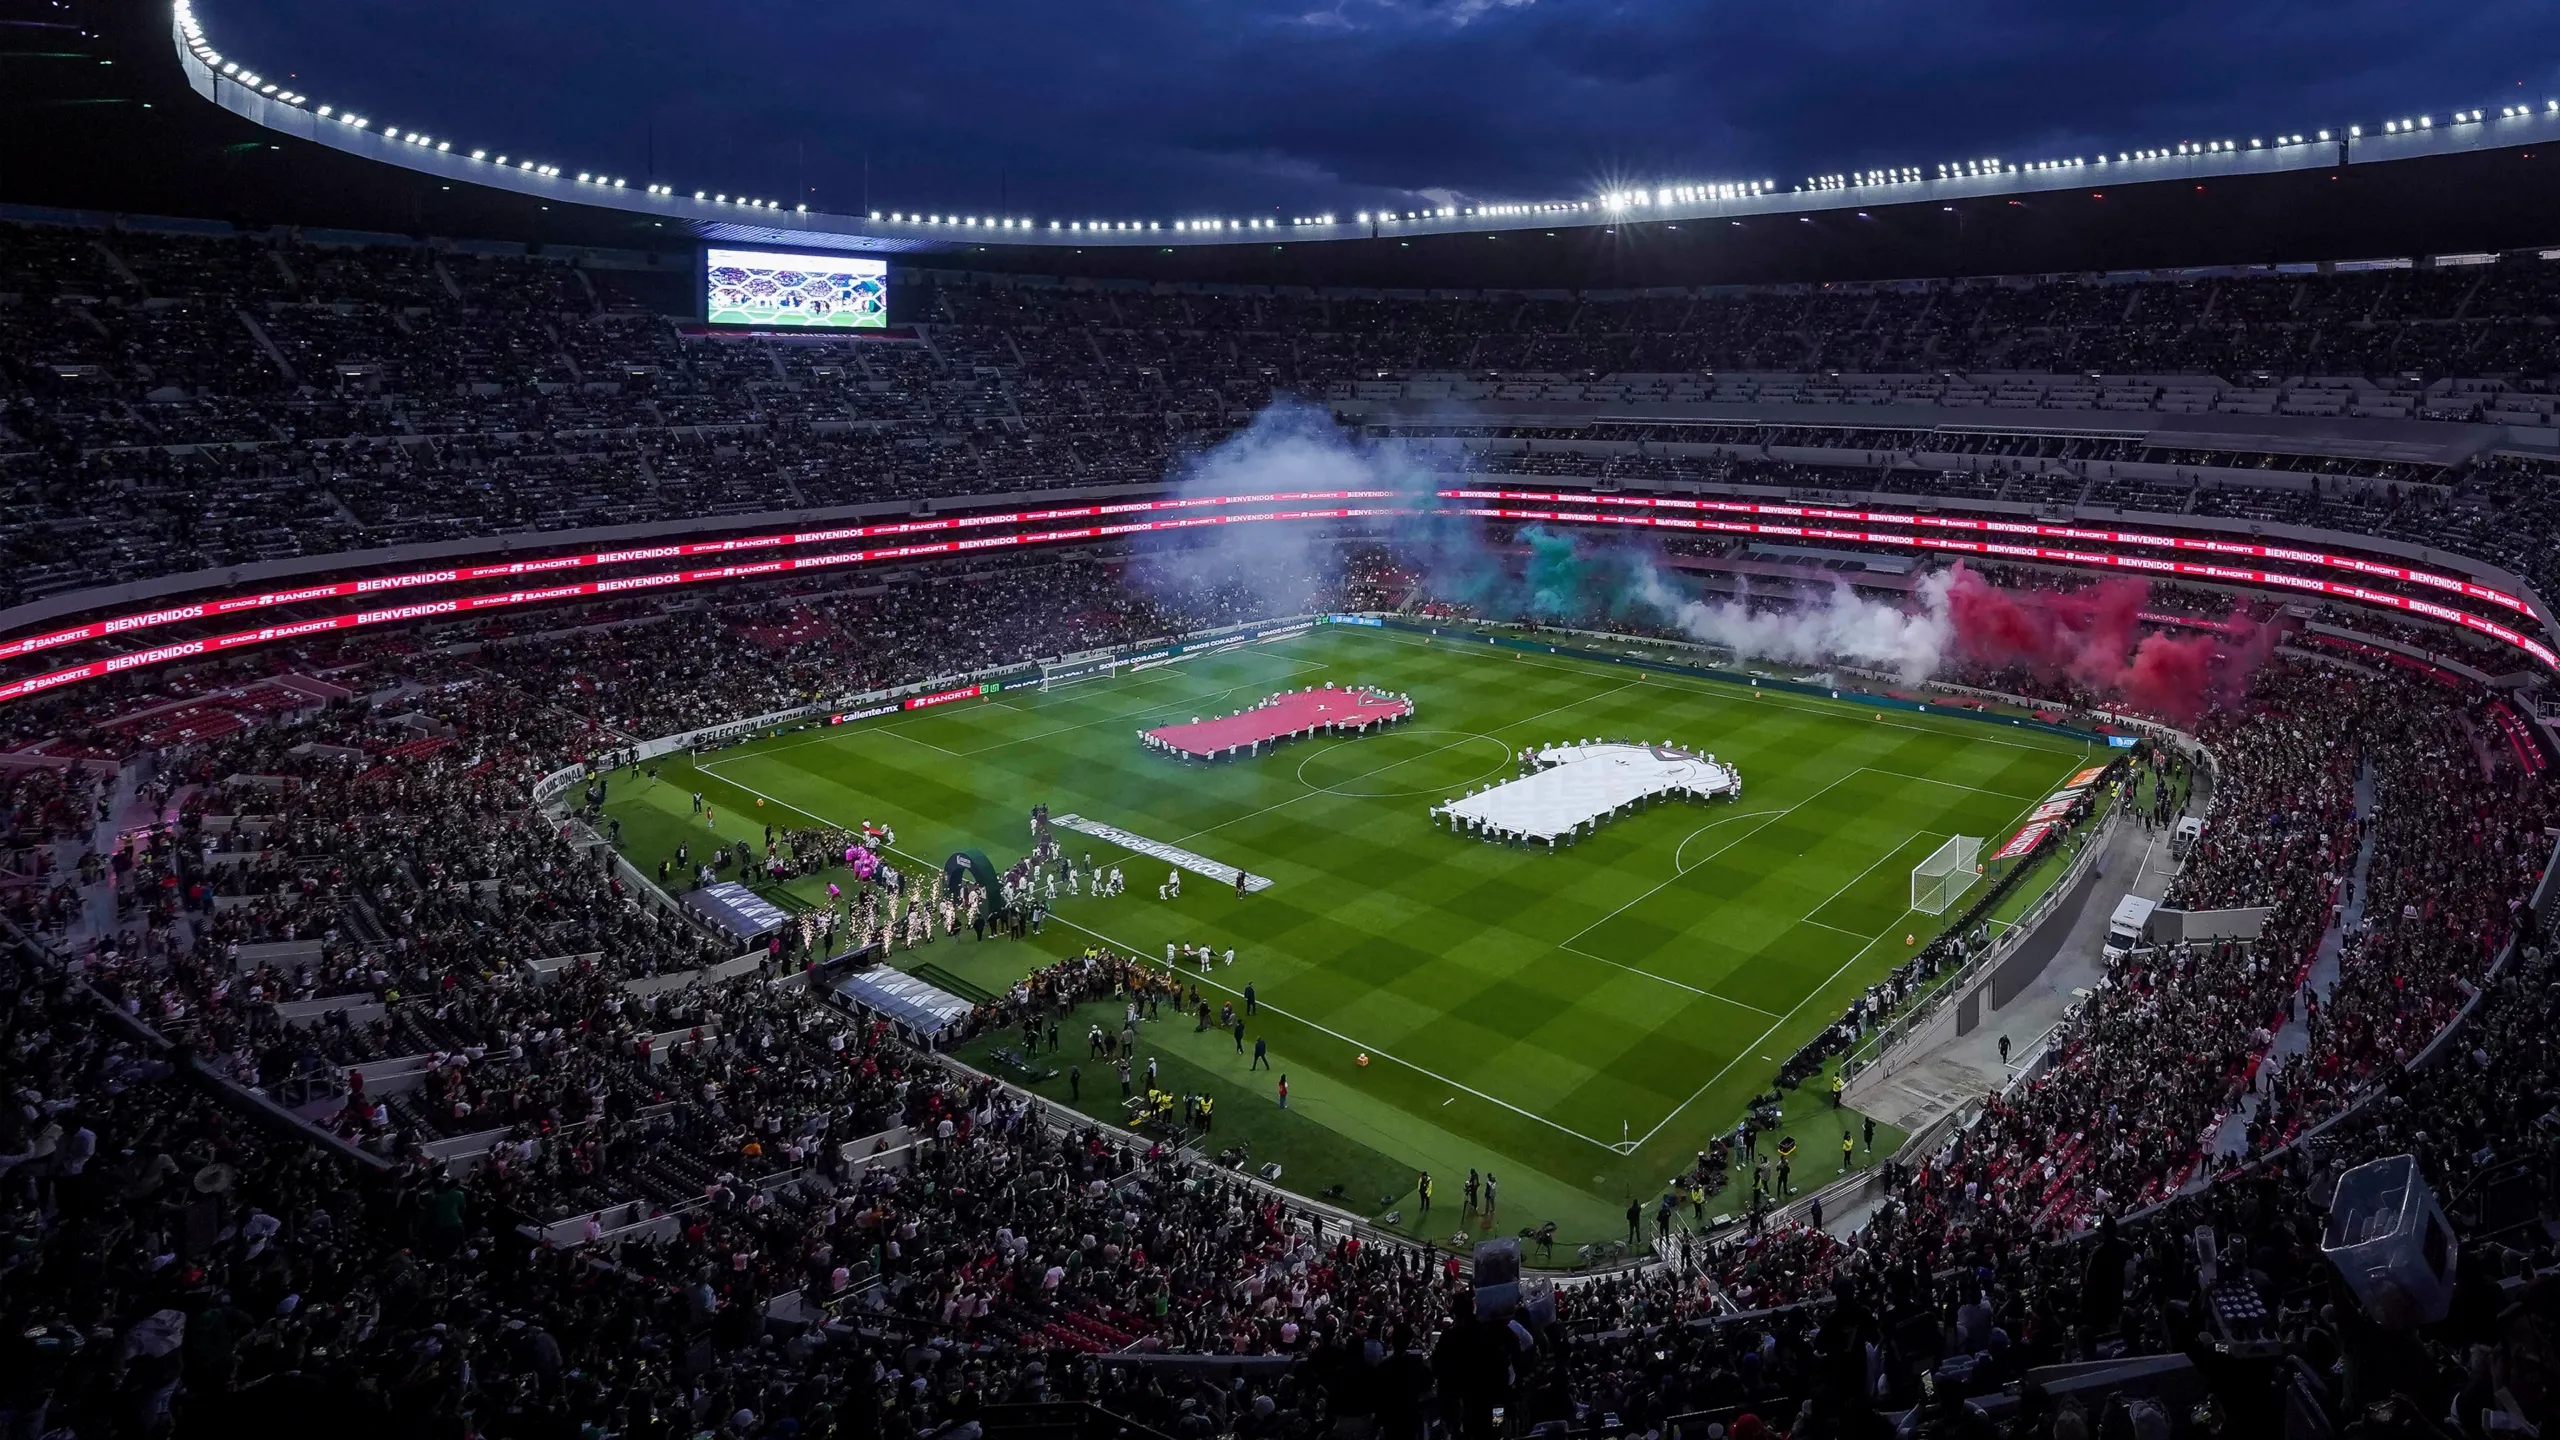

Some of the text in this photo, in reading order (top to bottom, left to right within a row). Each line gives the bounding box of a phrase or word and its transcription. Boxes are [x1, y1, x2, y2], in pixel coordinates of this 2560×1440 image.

[1224, 494, 1274, 503] BIENVENIDOS
[1100, 502, 1152, 514] BIENVENIDOS
[958, 514, 1017, 526] BIENVENIDOS
[1224, 514, 1274, 522] BIENVENIDOS
[910, 522, 948, 531] BANORTE
[1100, 523, 1152, 534] BIENVENIDOS
[1986, 522, 2038, 534] BIENVENIDOS
[794, 528, 862, 542] BIENVENIDOS
[1056, 530, 1090, 538] BANORTE
[2074, 531, 2108, 540] BANORTE
[2118, 533, 2174, 546] BIENVENIDOS
[736, 538, 780, 548] BANORTE
[910, 545, 948, 554] BANORTE
[958, 536, 1017, 549] BIENVENIDOS
[2216, 544, 2252, 554] BANORTE
[596, 546, 680, 563] BIENVENIDOS
[1986, 544, 2038, 556] BIENVENIDOS
[2264, 548, 2324, 564] BIENVENIDOS
[525, 558, 580, 570] BANORTE
[794, 552, 862, 568] BIENVENIDOS
[2074, 552, 2108, 563] BANORTE
[2118, 557, 2174, 571] BIENVENIDOS
[736, 564, 780, 574] BANORTE
[2216, 569, 2252, 579] BANORTE
[2364, 564, 2399, 576] BANORTE
[356, 571, 456, 592] BIENVENIDOS
[596, 574, 680, 592] BIENVENIDOS
[2264, 574, 2323, 590] BIENVENIDOS
[2409, 571, 2462, 592] BIENVENIDOS
[274, 587, 336, 602] BANORTE
[526, 587, 580, 600] BANORTE
[2364, 592, 2398, 605] BANORTE
[2494, 593, 2520, 609] BANORTE
[357, 601, 456, 624] BIENVENIDOS
[2408, 600, 2460, 622] BIENVENIDOS
[104, 606, 202, 633] BIENVENIDOS
[276, 620, 336, 636] BANORTE
[1256, 628, 1281, 638] SOMOS
[2492, 626, 2518, 643] BANORTE
[36, 629, 90, 648] BANORTE
[1182, 634, 1245, 652] SOMOS CORAZÓN
[106, 642, 204, 671] BIENVENIDOS
[2524, 639, 2555, 666] BIENVENIDOS
[1099, 659, 1130, 670] SOMOS
[1130, 651, 1168, 664] CORAZÓN
[36, 668, 90, 688] BANORTE
[927, 690, 973, 704] BANORTE
[842, 704, 899, 722] caliente.mx
[1088, 828, 1150, 852] SOMOS
